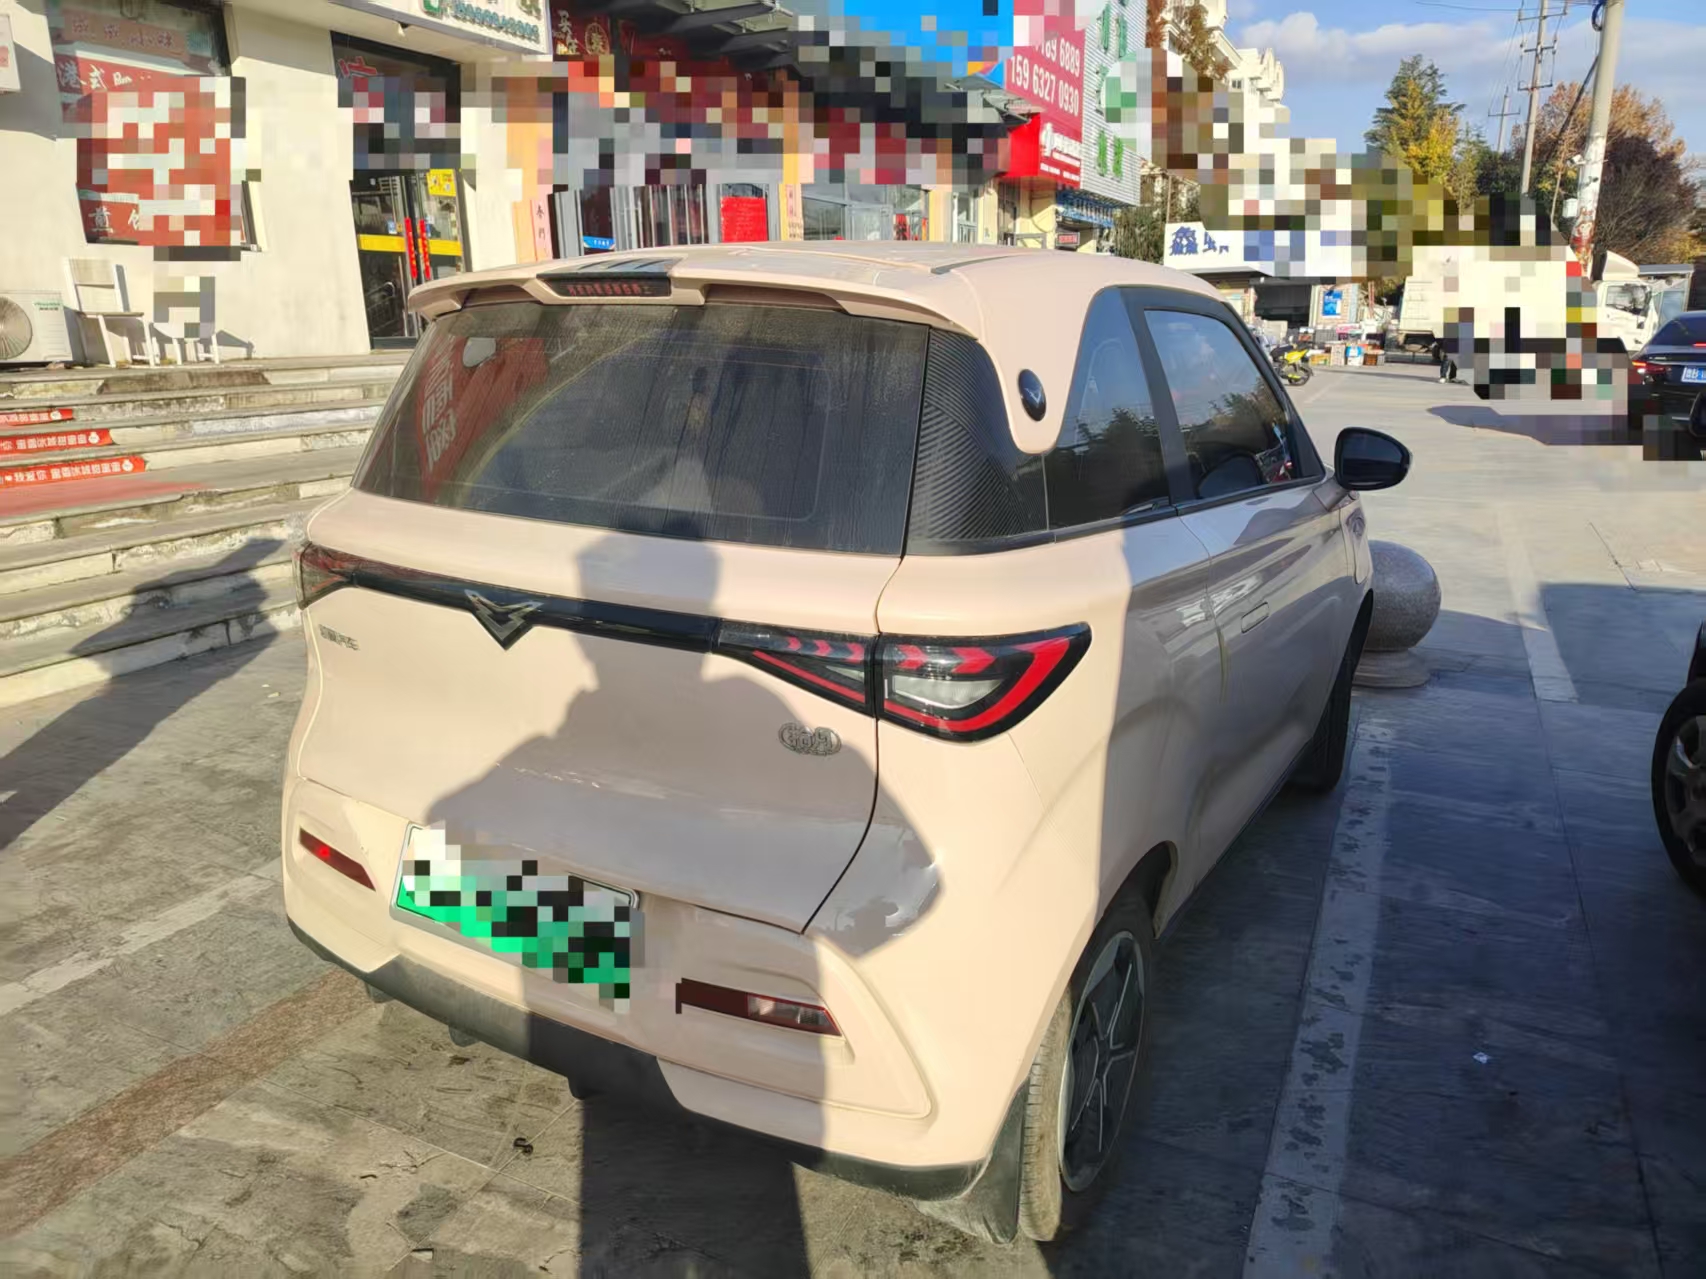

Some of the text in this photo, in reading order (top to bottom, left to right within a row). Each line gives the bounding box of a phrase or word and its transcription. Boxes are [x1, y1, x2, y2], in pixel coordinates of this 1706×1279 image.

[1059, 37, 1080, 78] 6889
[1010, 53, 1079, 117] 159 6327 0930
